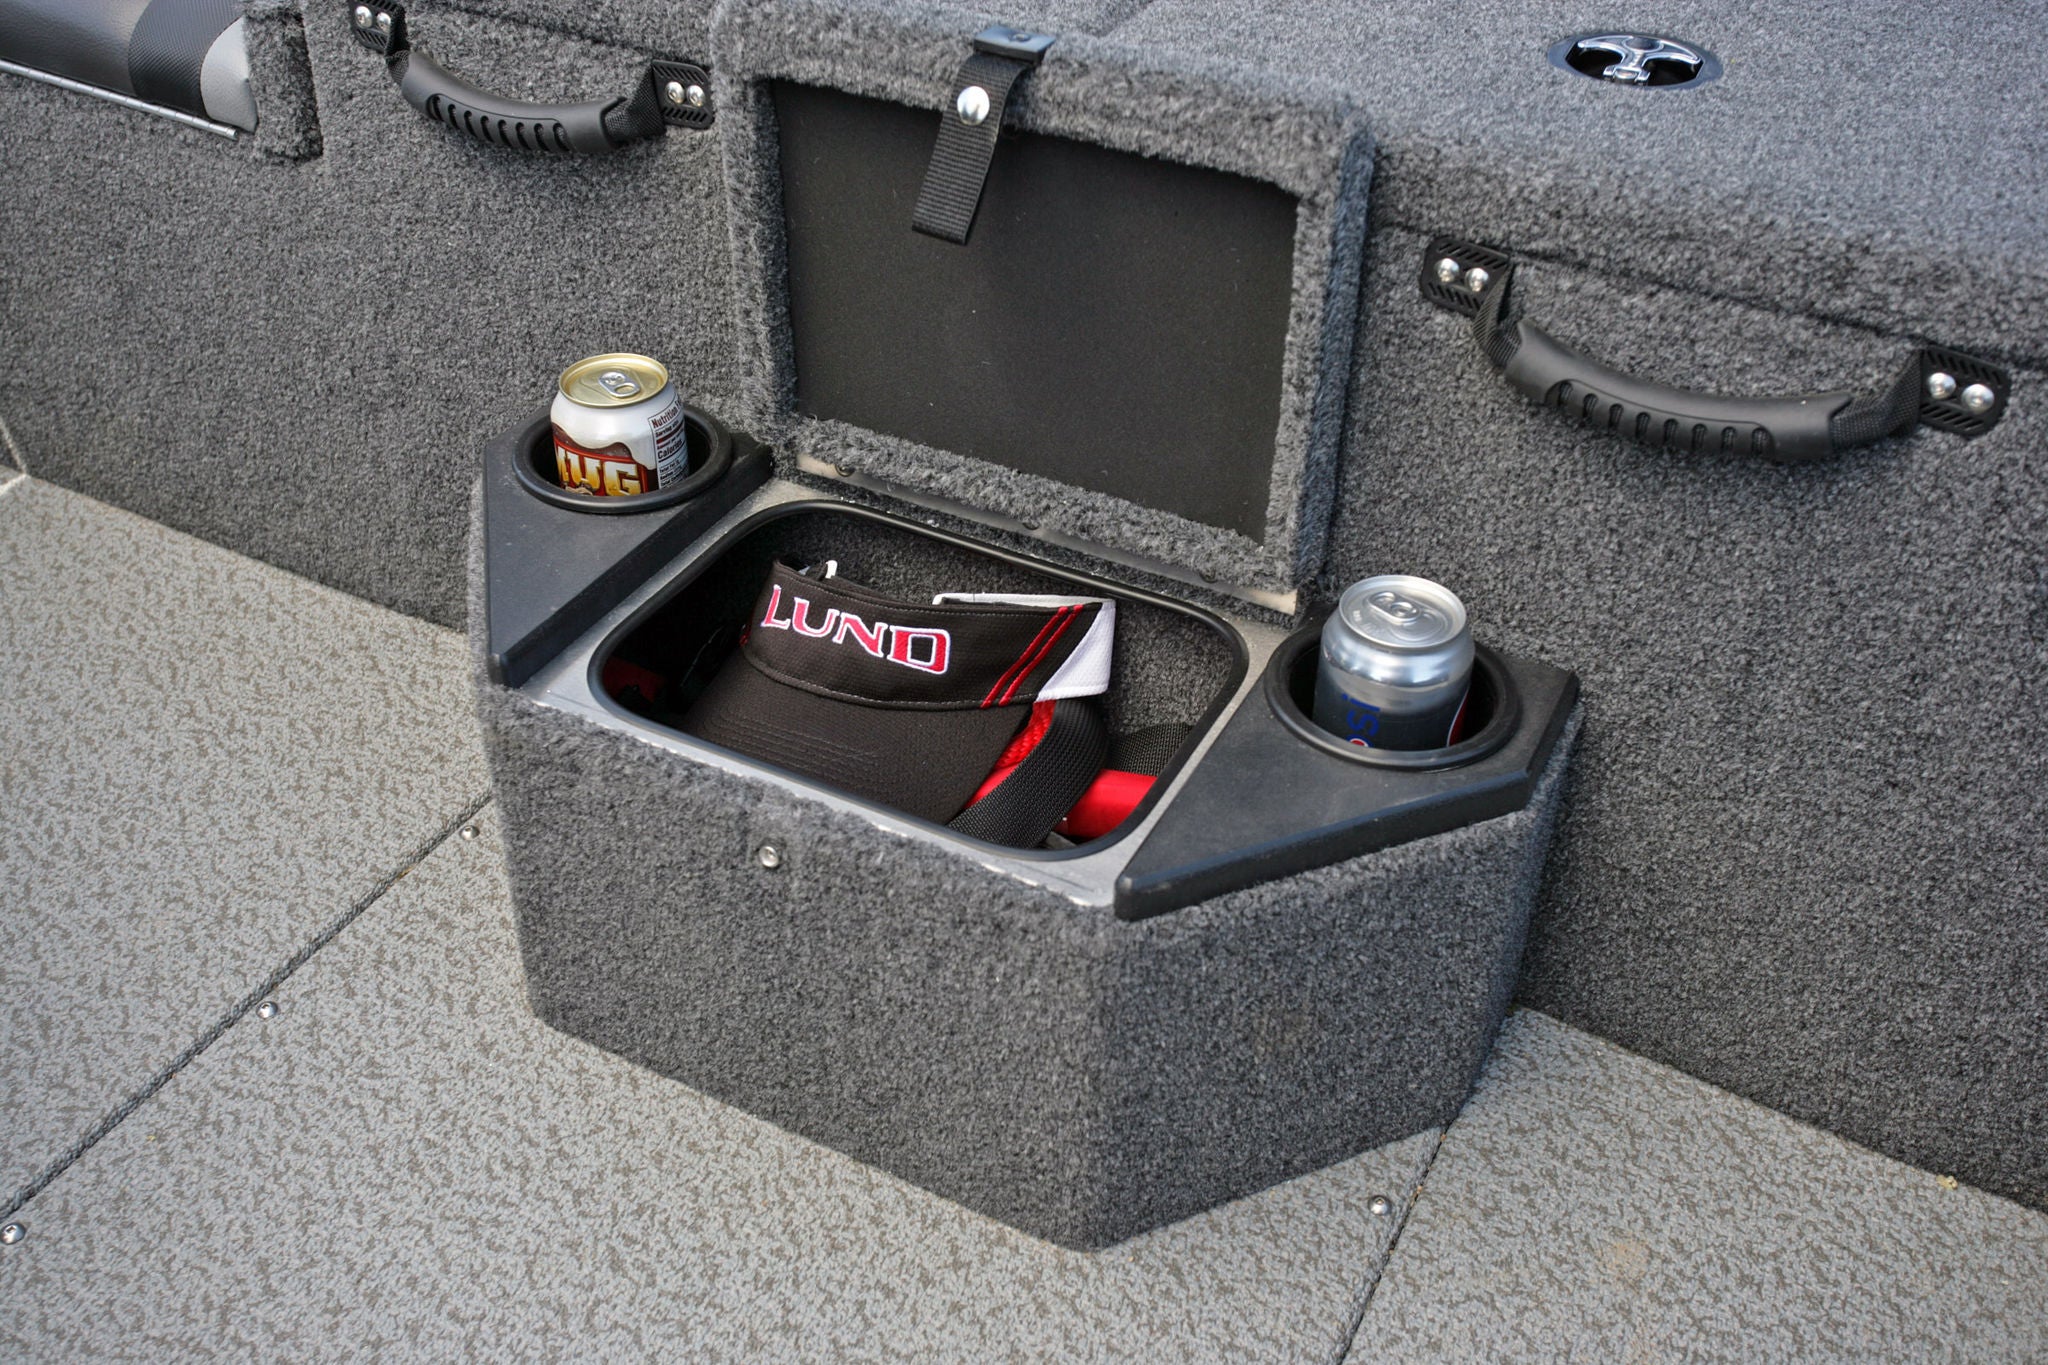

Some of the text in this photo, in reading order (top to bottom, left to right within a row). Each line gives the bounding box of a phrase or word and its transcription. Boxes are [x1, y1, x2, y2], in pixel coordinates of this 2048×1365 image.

[651, 406, 679, 429] Nutrition
[657, 439, 683, 460] Calories
[761, 584, 951, 675] LUND
